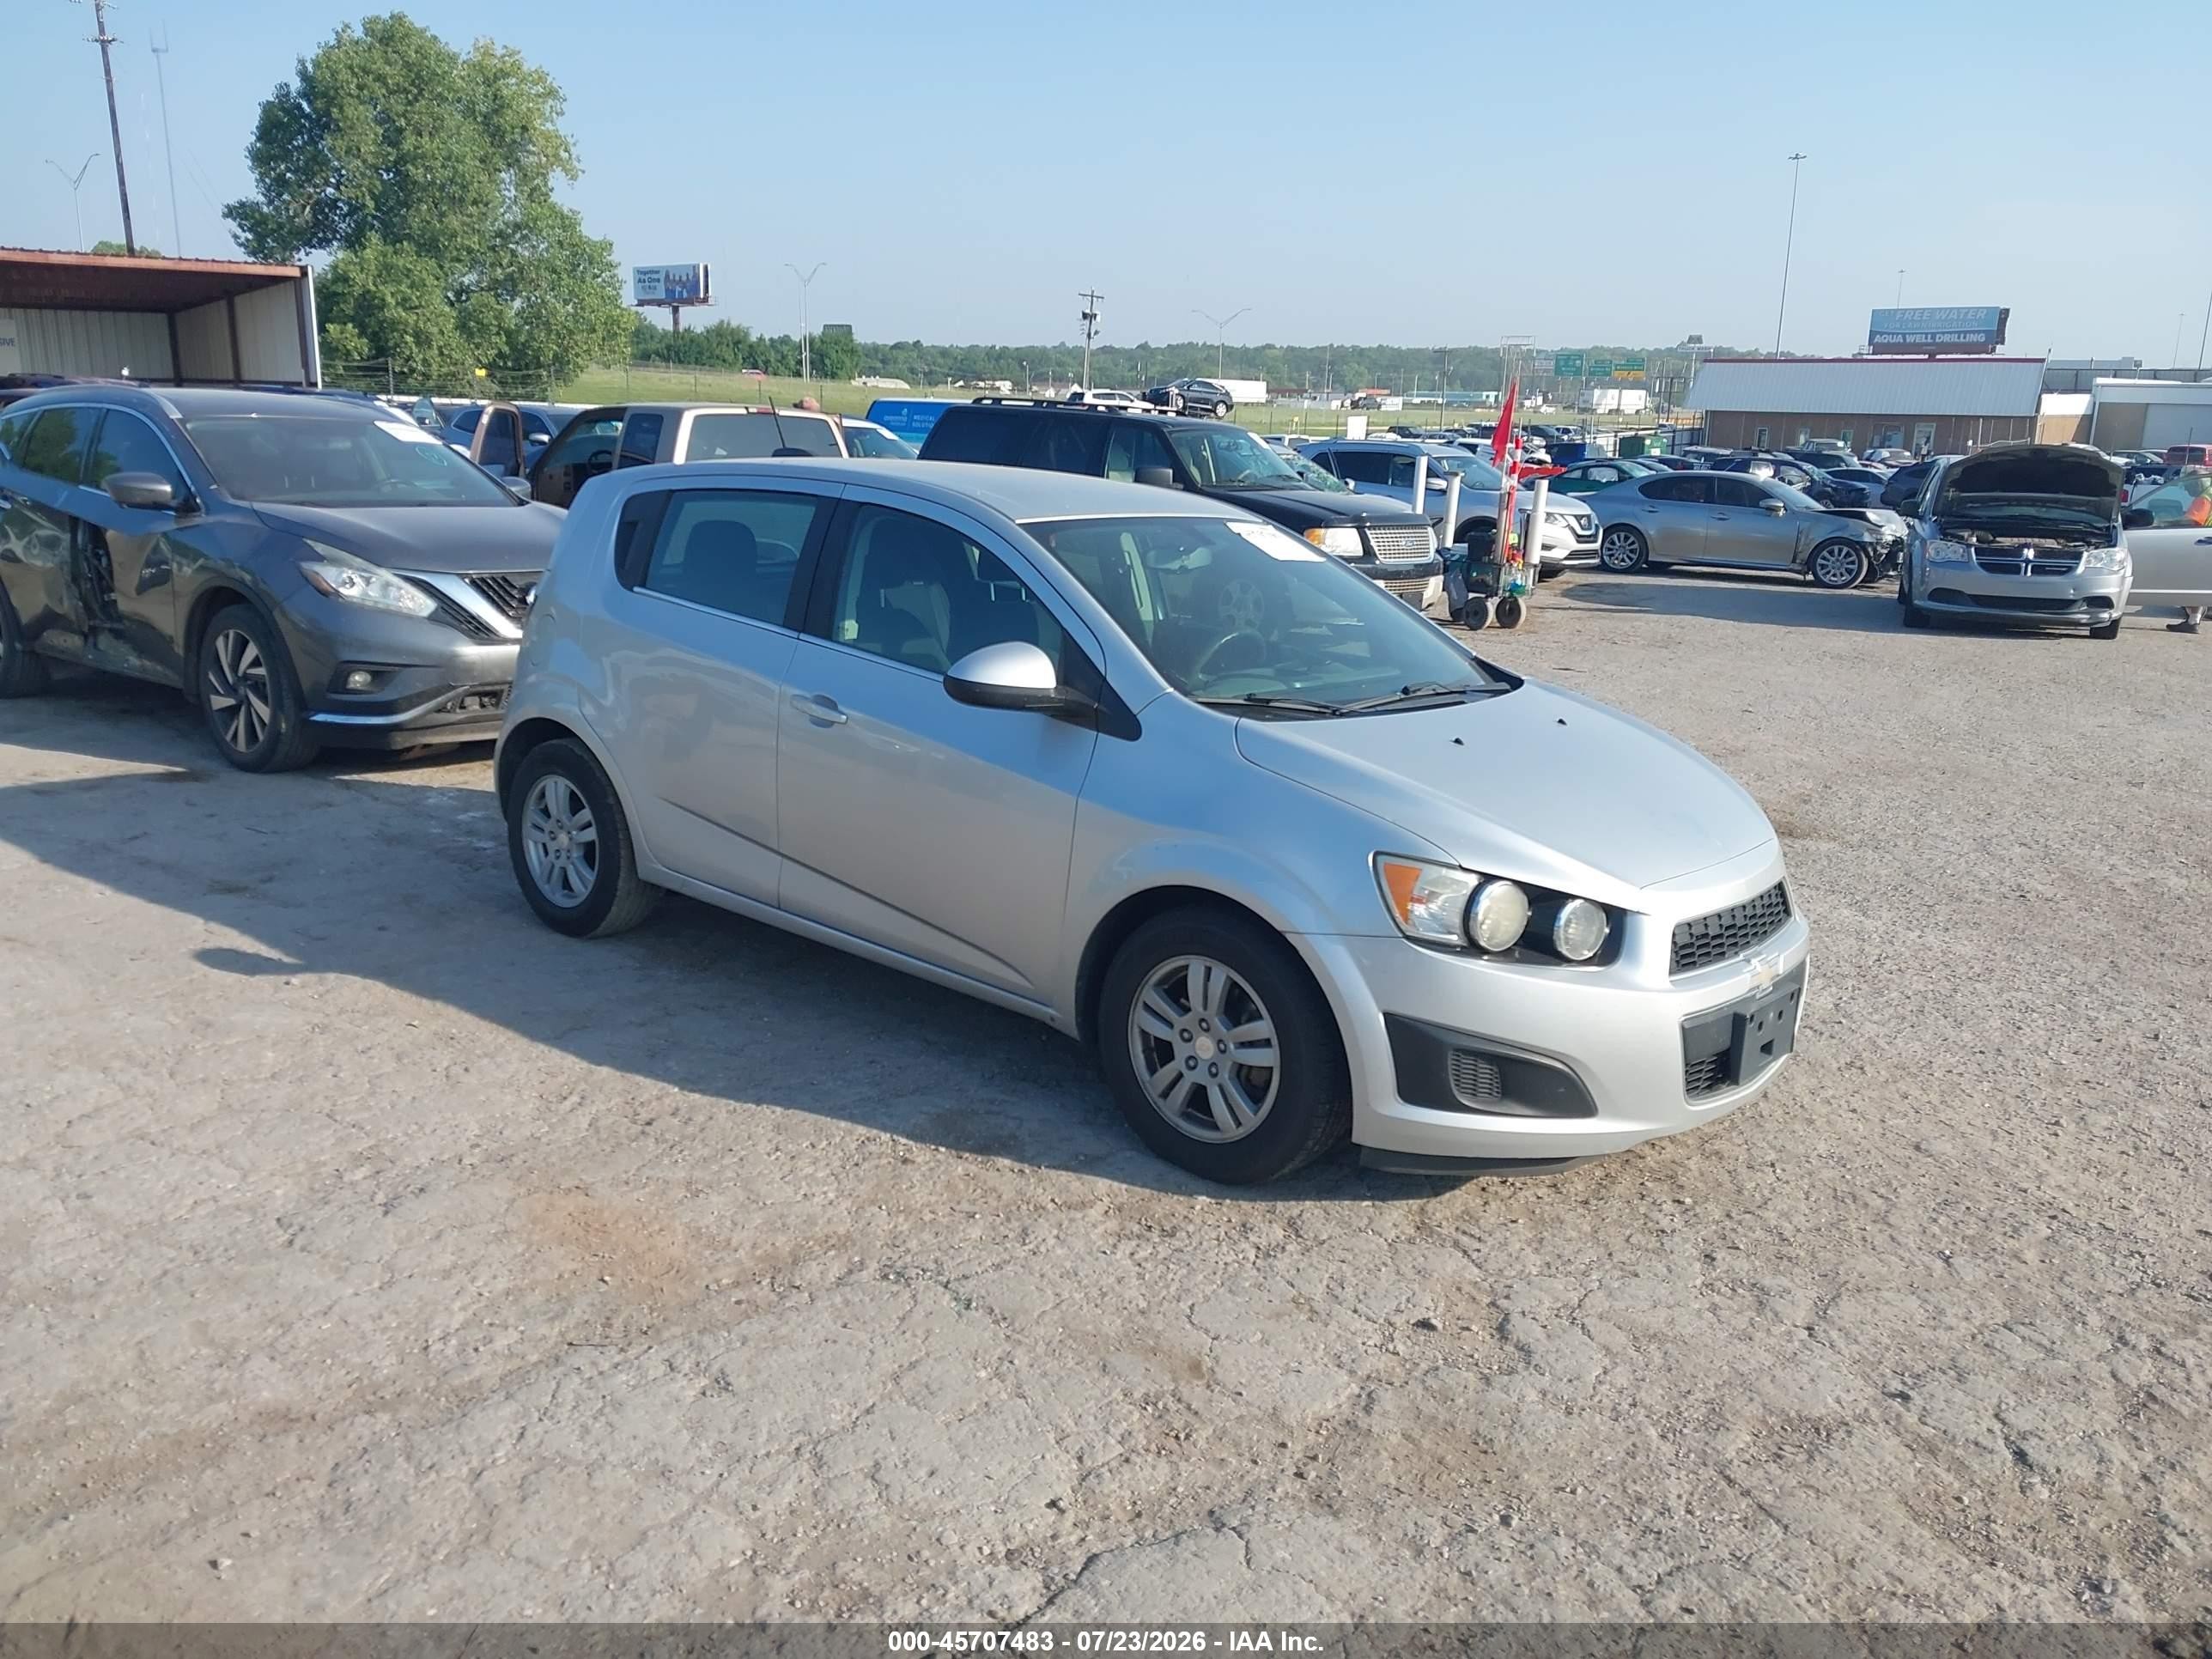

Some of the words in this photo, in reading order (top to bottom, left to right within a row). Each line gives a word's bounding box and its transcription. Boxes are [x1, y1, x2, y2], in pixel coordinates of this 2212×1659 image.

[1895, 310, 1932, 321] FREE
[1936, 308, 1987, 320] WATER
[1874, 334, 1904, 343] AQUA
[1905, 333, 1936, 343] WELL
[1936, 332, 1986, 343] DRILLING
